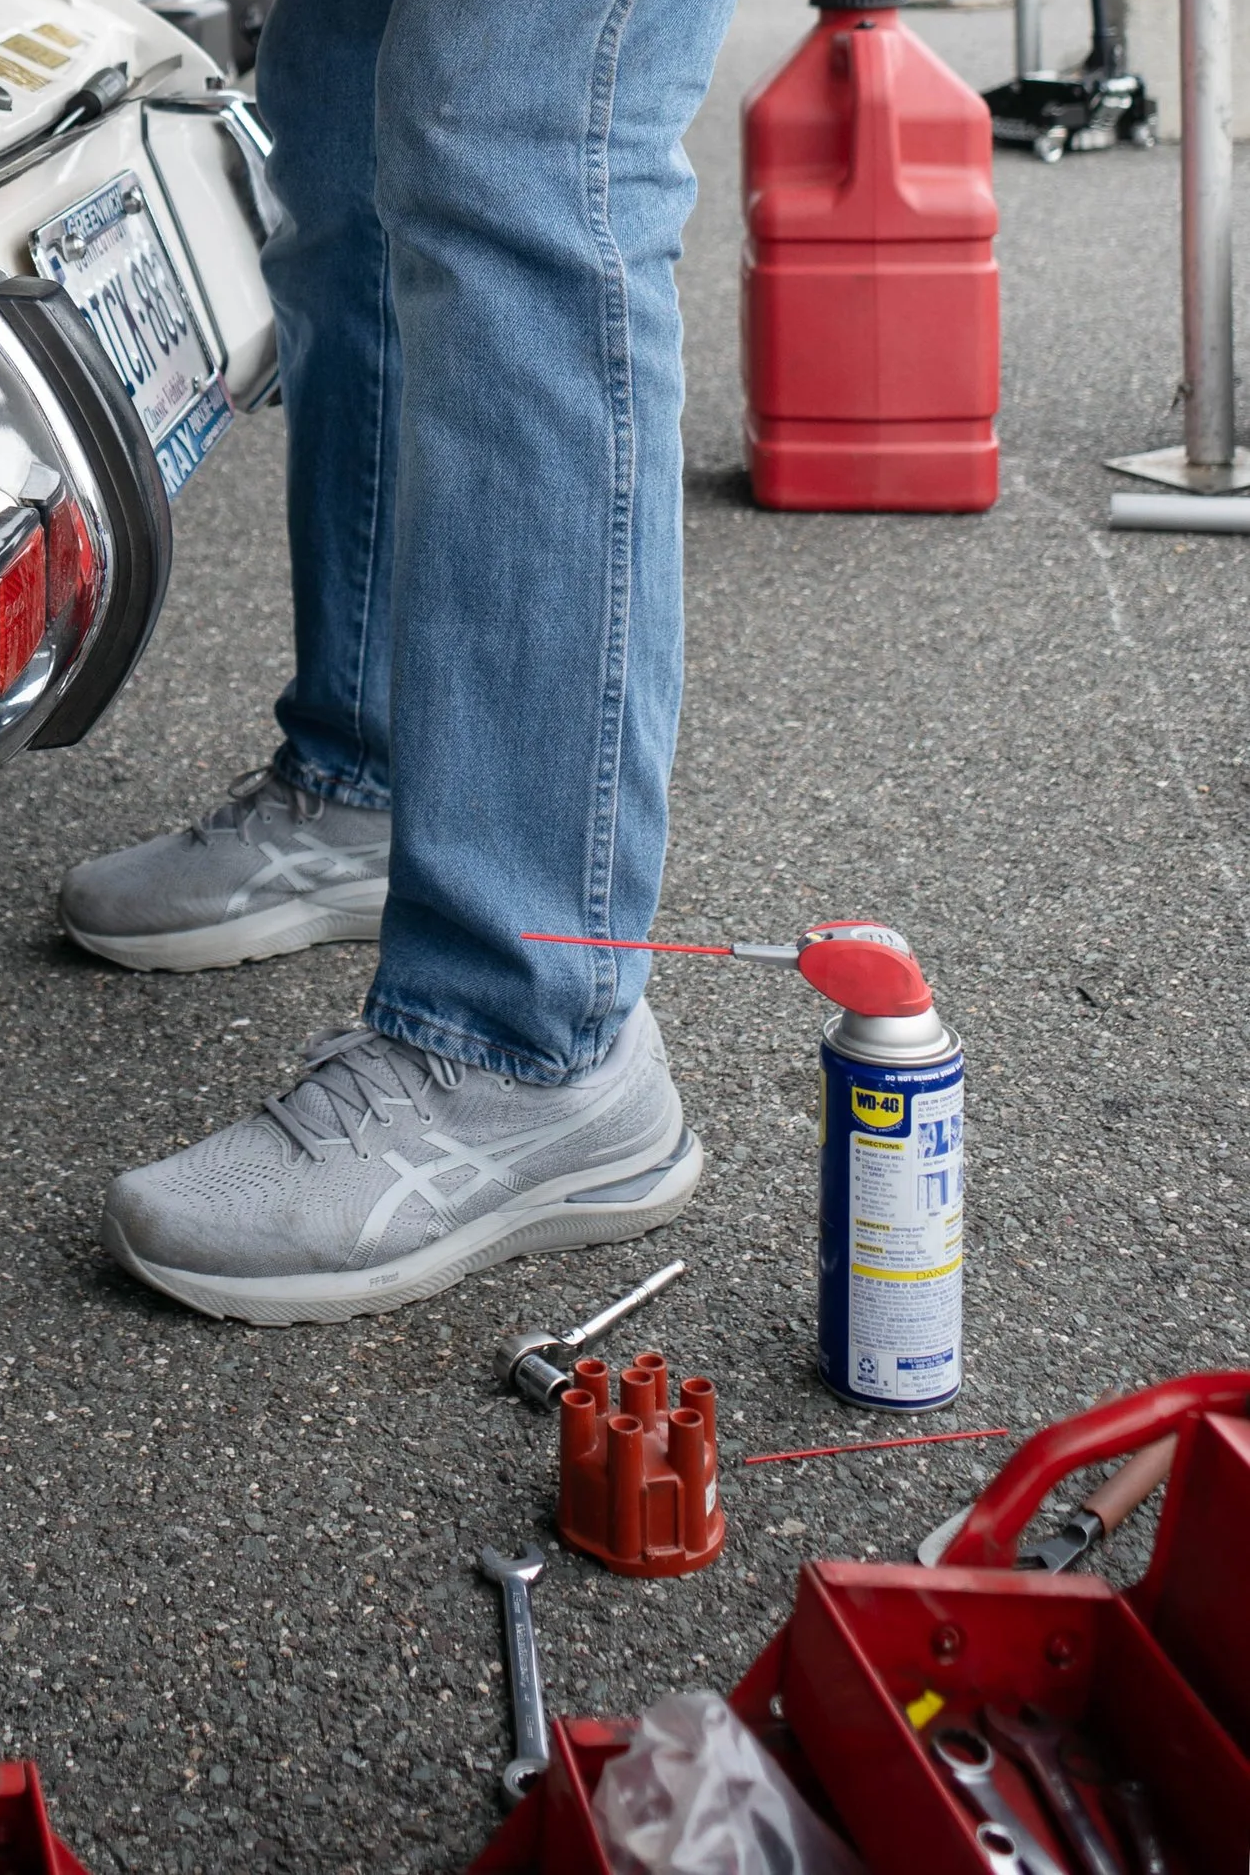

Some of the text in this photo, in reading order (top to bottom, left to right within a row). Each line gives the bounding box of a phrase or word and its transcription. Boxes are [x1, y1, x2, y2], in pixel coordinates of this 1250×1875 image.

[67, 186, 123, 238] GREENWICH
[157, 421, 199, 495] RAY
[855, 1091, 900, 1114] WD-40
[858, 1137, 903, 1150] DIRECTIONS:
